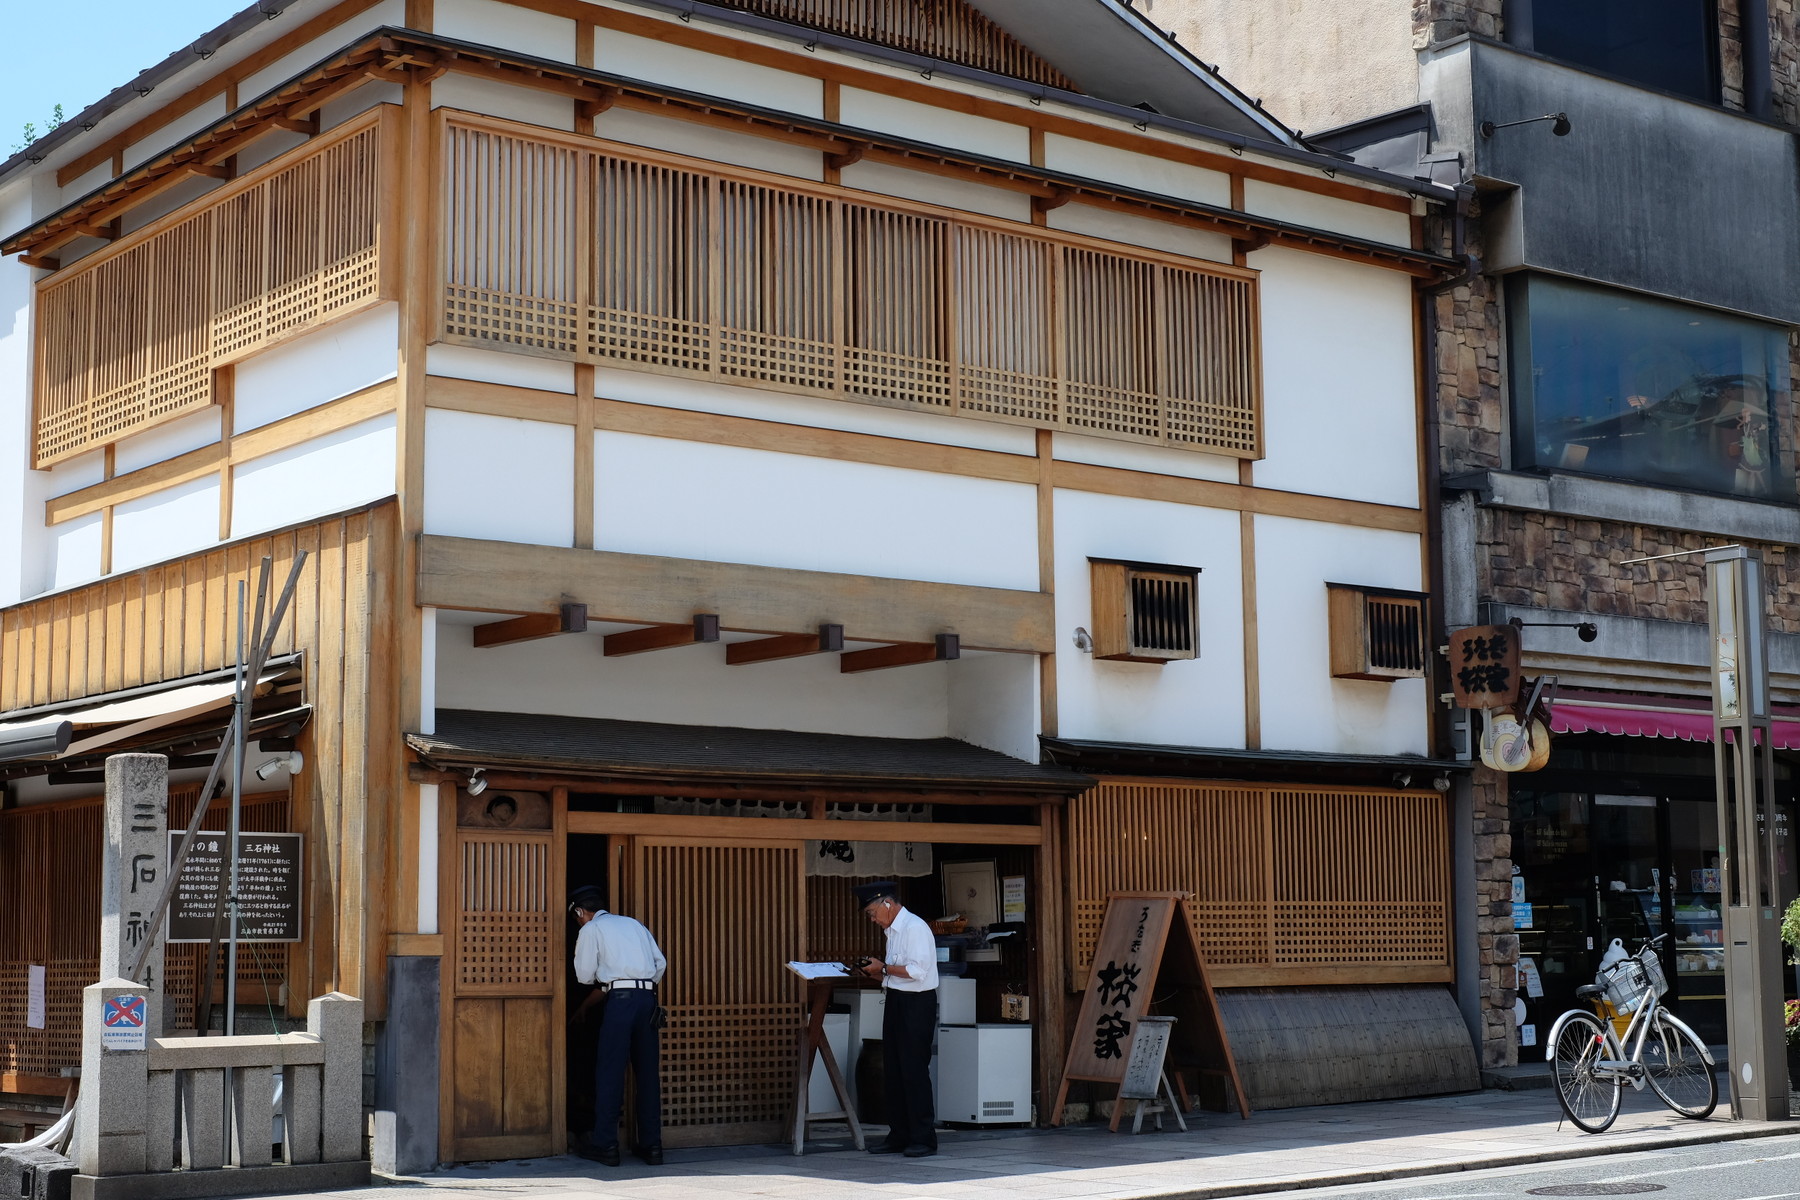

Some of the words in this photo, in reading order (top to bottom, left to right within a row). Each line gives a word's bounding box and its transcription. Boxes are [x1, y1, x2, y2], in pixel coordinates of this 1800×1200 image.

[190, 841, 219, 852] の鐘
[244, 843, 281, 854] 三石神社
[1093, 960, 1142, 1061] 桜家
